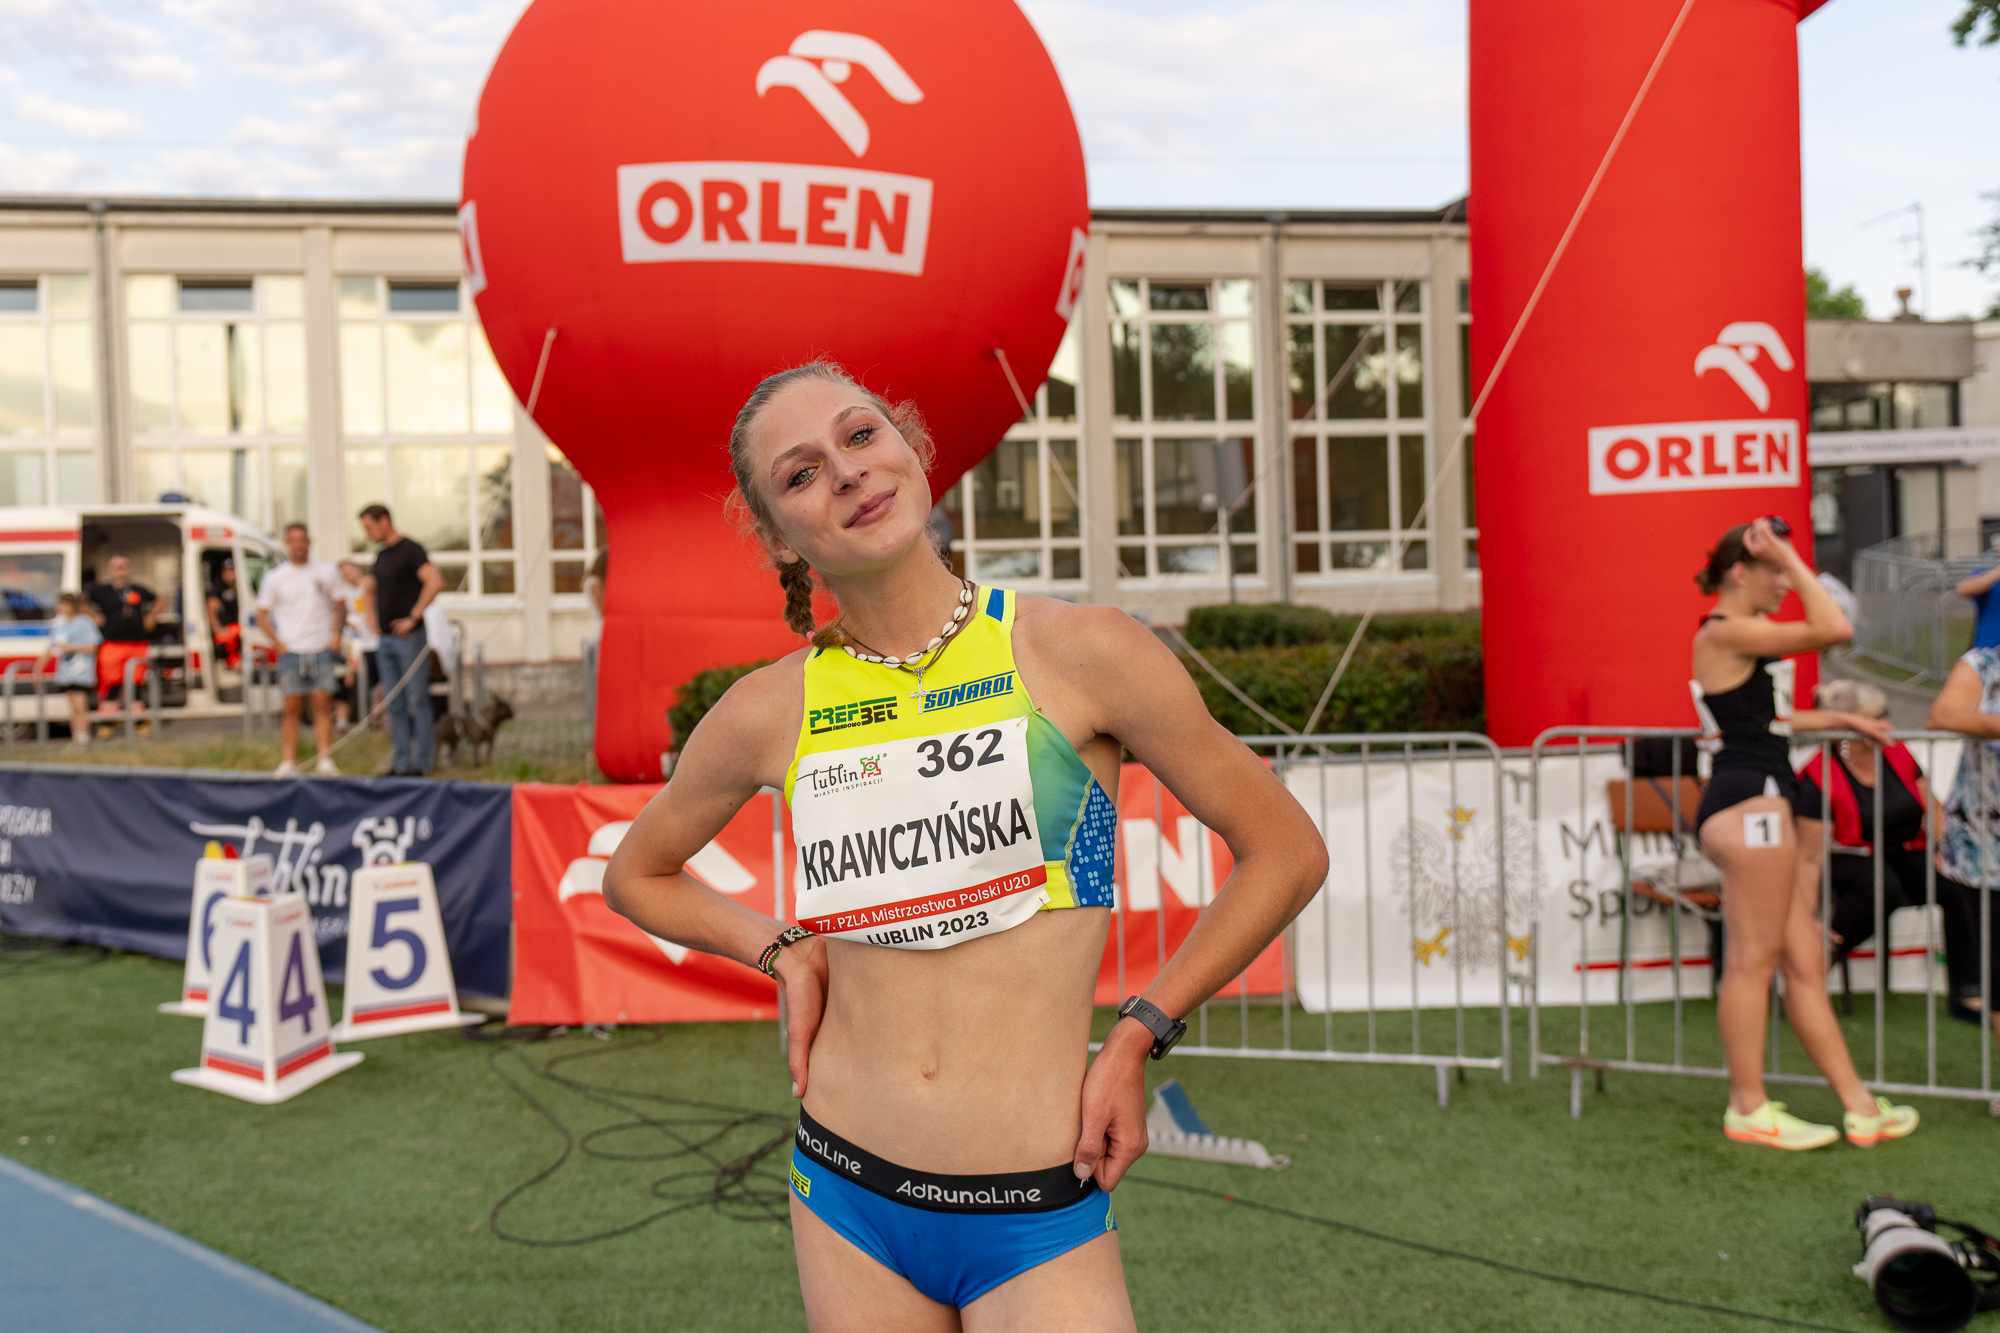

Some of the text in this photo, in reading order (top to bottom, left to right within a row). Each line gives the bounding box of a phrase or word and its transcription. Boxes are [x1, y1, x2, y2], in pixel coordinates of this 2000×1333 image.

[637, 179, 911, 256] ORLEN
[1605, 432, 1790, 480] ORLEN
[809, 701, 898, 729] PREFBET
[924, 674, 1014, 710] SONAROL
[916, 728, 1005, 779] 362
[814, 778, 883, 798] MIASTO INSPIRACJI
[801, 798, 1032, 891] KRAWCZYŃSKA
[1755, 815, 1771, 844] 1
[816, 874, 1031, 932] 77. PZLA Mistrzostwa Polski U20
[867, 911, 990, 946] LUBLIN 2023
[371, 898, 427, 990] 5
[219, 940, 256, 1045] 4
[279, 931, 315, 1034] 4
